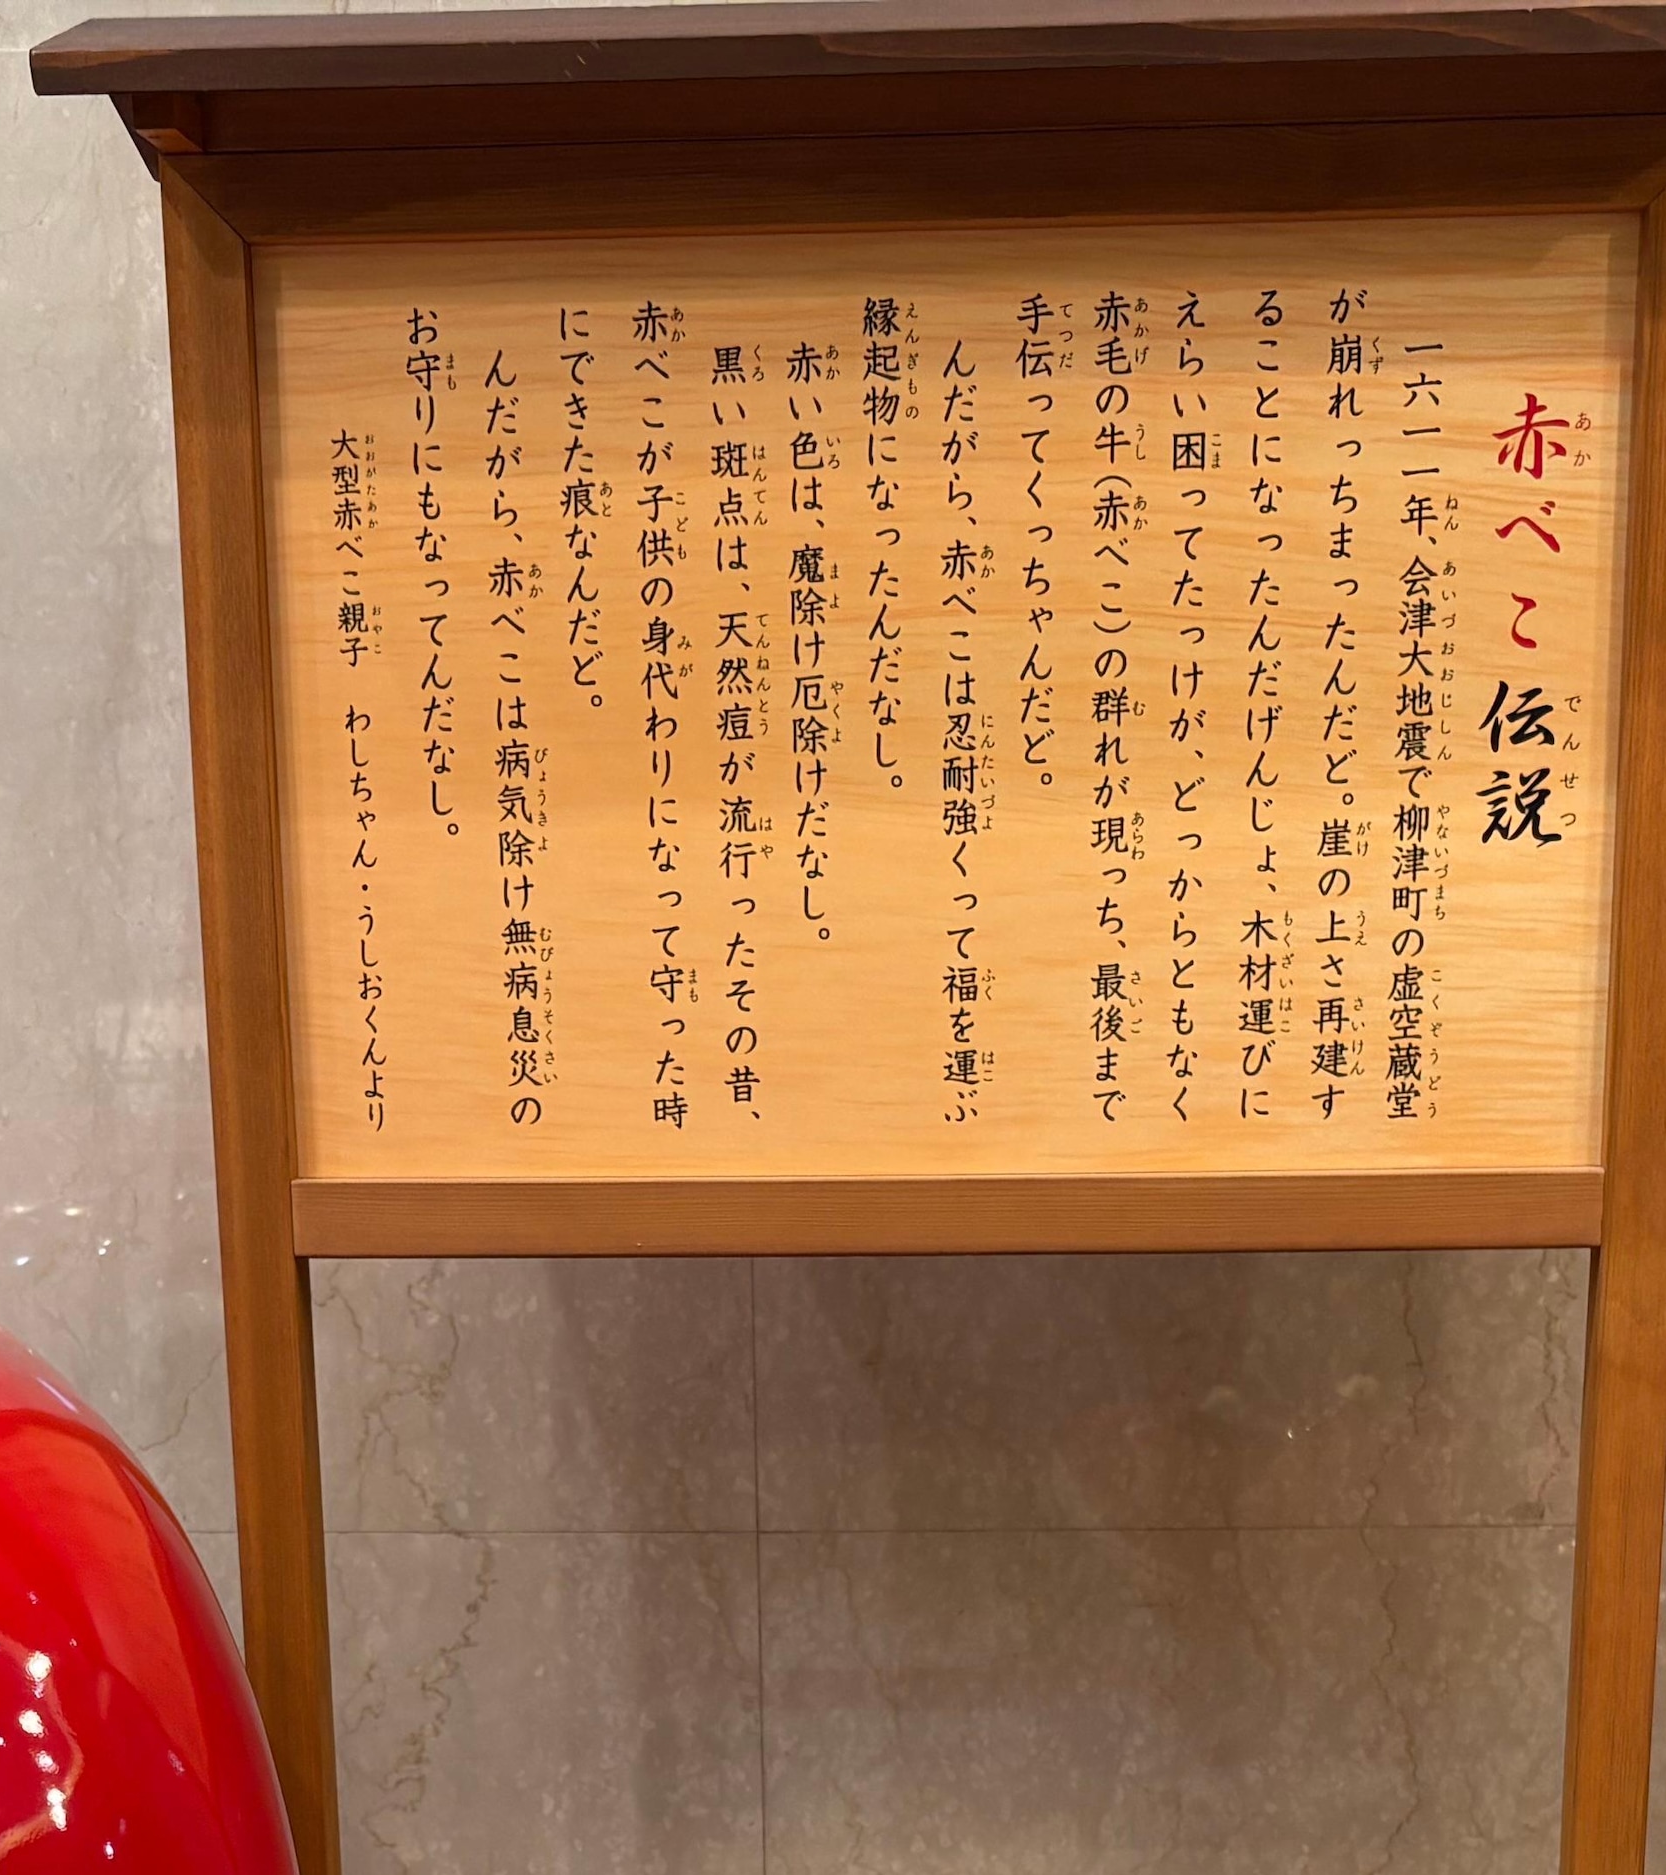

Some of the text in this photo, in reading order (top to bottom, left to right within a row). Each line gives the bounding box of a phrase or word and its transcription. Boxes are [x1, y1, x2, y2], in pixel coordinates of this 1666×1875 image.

[331, 429, 387, 1132] 大型赤べこ親子 わしちゃん・うしおくんより
[406, 308, 460, 836] お守りにもなってんだなし。
[484, 350, 542, 1125] んだがら、赤べこは病気除け無病息災の
[559, 307, 602, 707] にできた痕なんだど。
[633, 300, 688, 1129] 赤べこが子供の身代わりになって守った時
[710, 346, 761, 1120] 黒い斑点は、天然痘が流行ったその昔、
[786, 341, 830, 940] 赤い色は、魔除け厄除けだなし。
[863, 297, 903, 788] 縁起物になったんだなし。
[941, 340, 979, 1122] んだがら、赤べこは忍耐強くって福を運ぶ
[1016, 294, 1054, 786] 手伝ってくっちゃんだど。
[1167, 291, 1206, 1121] えらい困ってたっけが、どっからともなく
[1239, 289, 1283, 1118] ることになったんだげんじょ、木材運びに
[1311, 288, 1367, 1119] が崩れっちまったんだど。崖の上さ再建す
[1387, 346, 1444, 1119] 一六一一年、会津大地震で柳津町の虚空蔵堂
[1476, 393, 1570, 847] 赤べこ伝説
